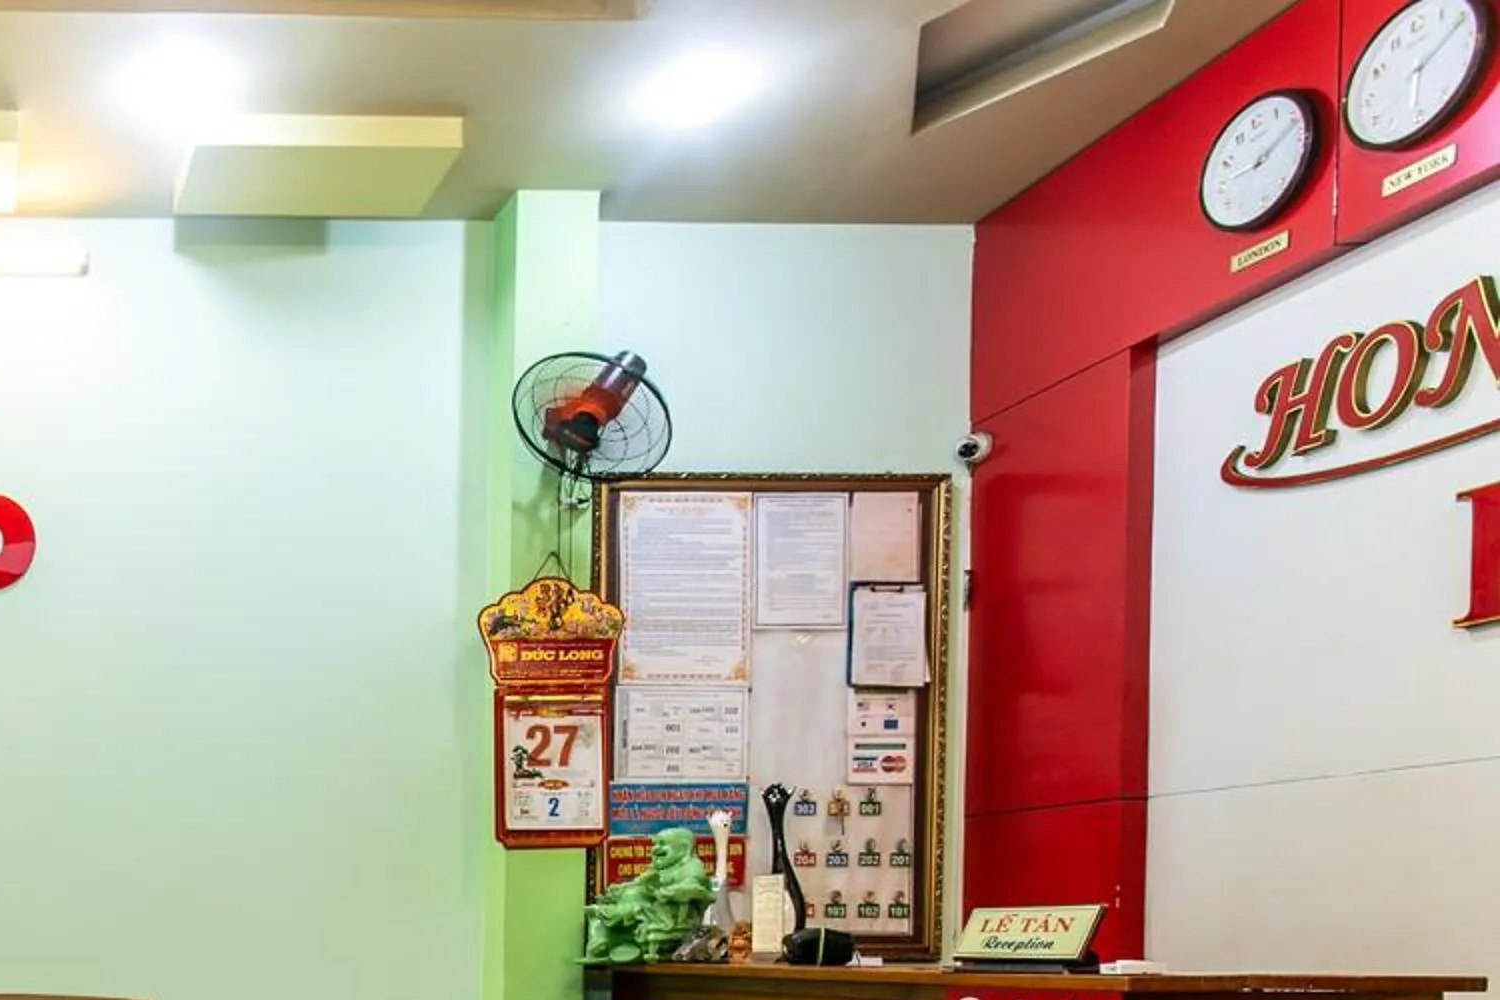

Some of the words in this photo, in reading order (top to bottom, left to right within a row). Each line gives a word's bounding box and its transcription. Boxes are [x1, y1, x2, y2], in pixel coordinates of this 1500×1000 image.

[1236, 237, 1284, 267] LONDON
[558, 649, 605, 661] LONG
[525, 724, 581, 768] 27
[547, 797, 561, 817] 2
[982, 935, 1055, 952] Reception
